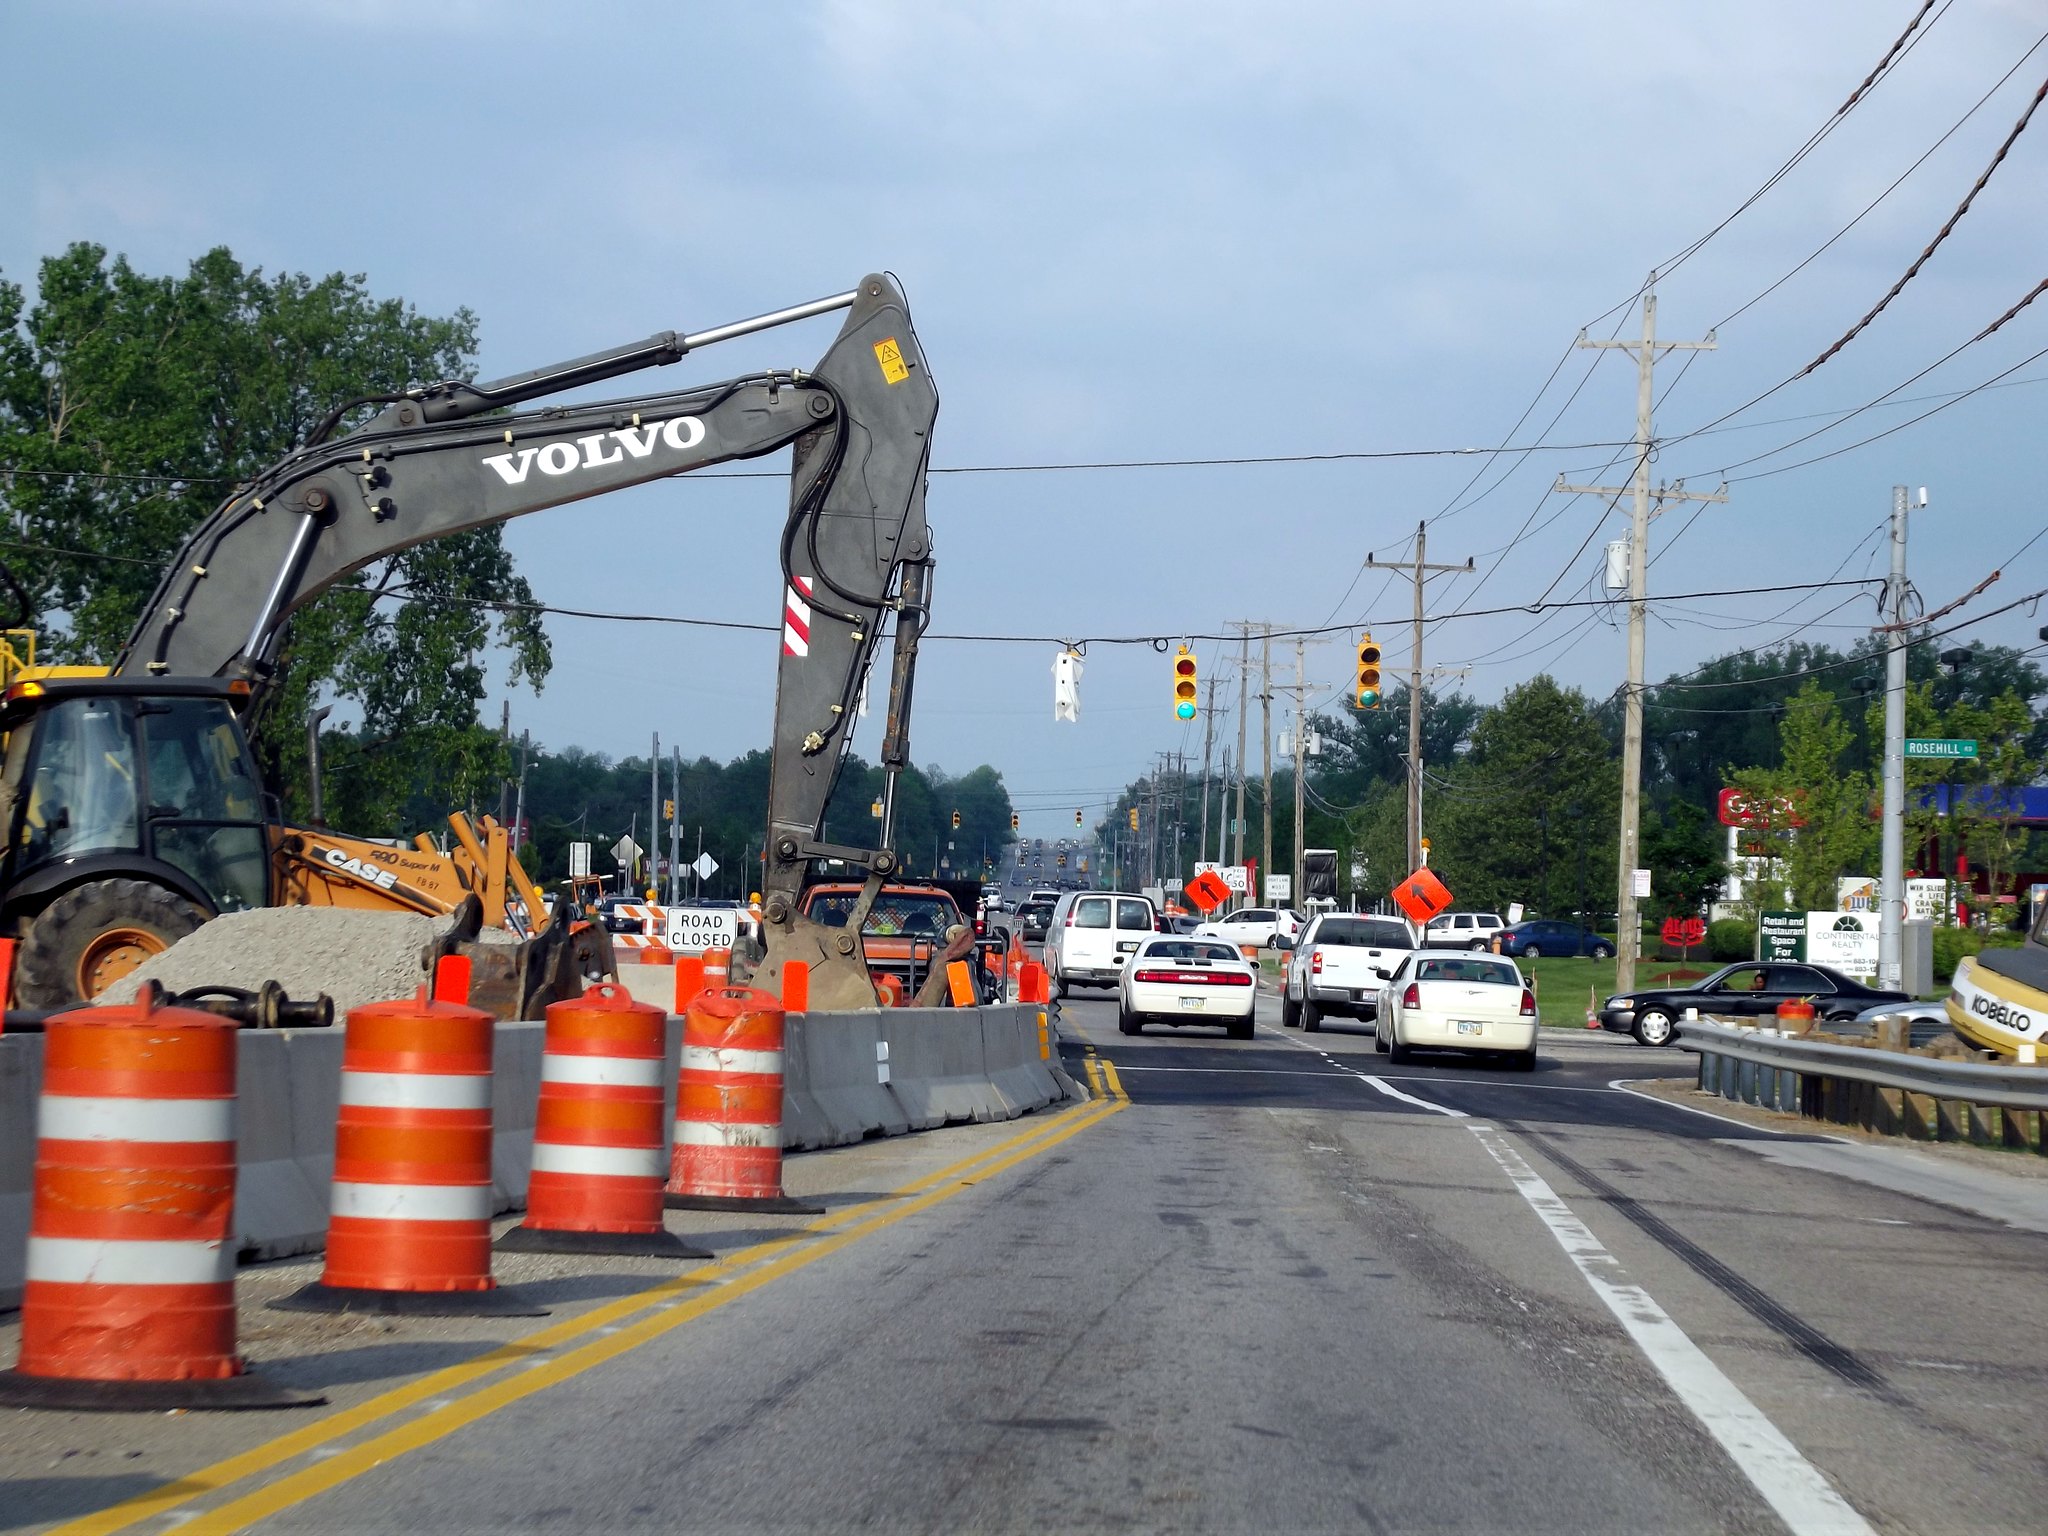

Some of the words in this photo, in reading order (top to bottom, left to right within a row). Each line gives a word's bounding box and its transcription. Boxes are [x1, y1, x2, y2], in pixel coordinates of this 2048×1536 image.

[482, 416, 706, 485] VOLVO
[1909, 742, 1960, 754] ROSEHILL
[370, 850, 399, 865] 590
[399, 858, 429, 871] Super
[430, 863, 441, 872] M
[325, 848, 399, 890] CASE
[681, 914, 723, 928] ROAD
[1763, 917, 1787, 926] Retail
[1788, 918, 1804, 926] and
[1762, 926, 1806, 935] Restaurant
[1815, 932, 1880, 940] CONTINENTAL
[672, 932, 731, 946] CLOSED
[1771, 936, 1796, 946] Space
[1775, 947, 1792, 956] For
[1971, 993, 2030, 1032] KOBELCO
